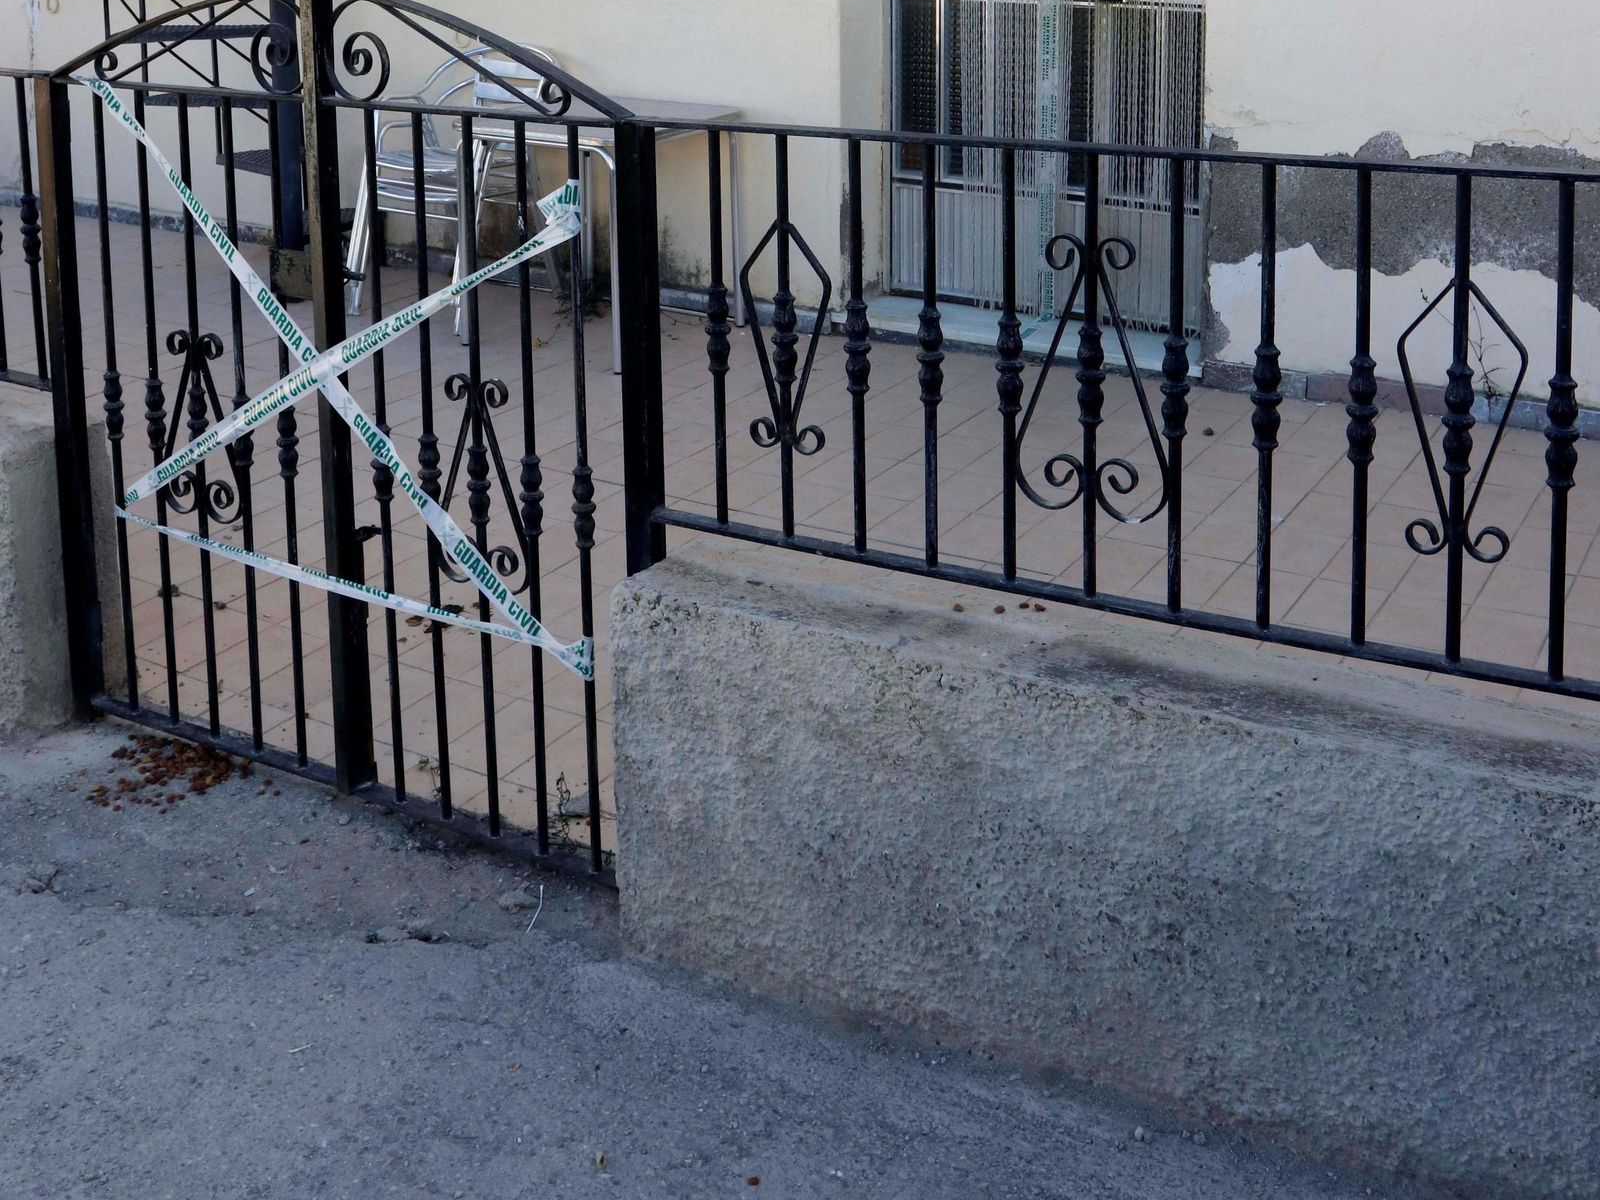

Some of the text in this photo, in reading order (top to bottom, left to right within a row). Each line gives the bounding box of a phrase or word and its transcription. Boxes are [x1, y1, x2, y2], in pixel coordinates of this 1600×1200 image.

[168, 168, 235, 263] GUARDIA CIVIL
[257, 287, 304, 351] GUARDIA
[242, 366, 318, 426] GUARDIA CIVIL
[453, 539, 508, 606] GUARDIA
